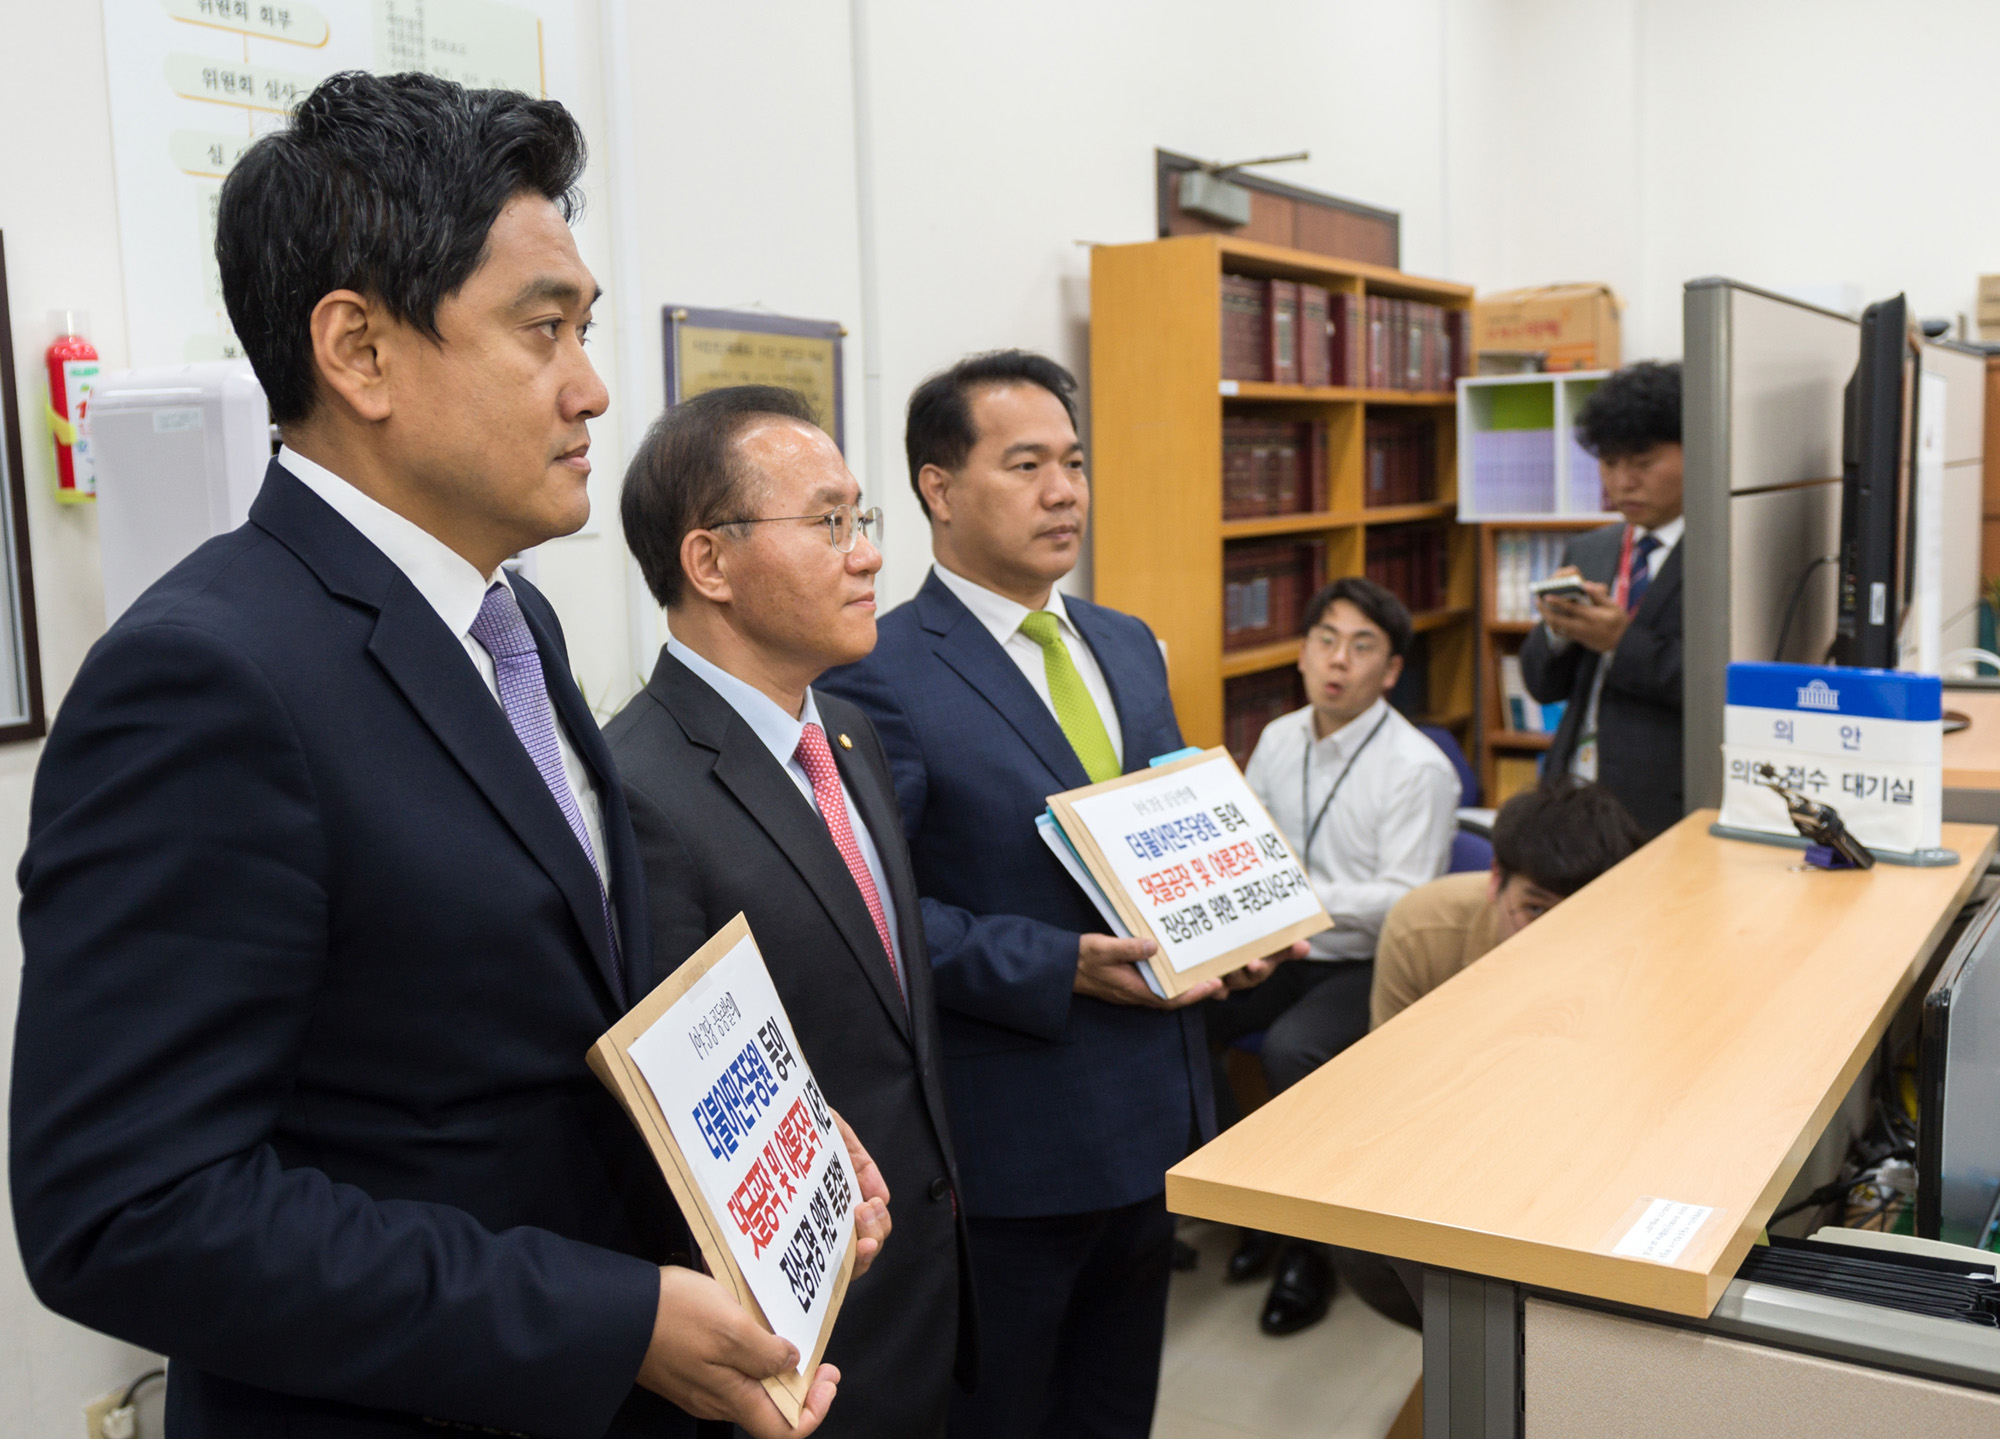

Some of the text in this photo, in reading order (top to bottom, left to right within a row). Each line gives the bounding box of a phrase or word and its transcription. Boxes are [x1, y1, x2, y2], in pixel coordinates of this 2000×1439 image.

[202, 67, 253, 96] 위원회
[1786, 765, 1829, 794] 접수
[1842, 773, 1915, 805] 대기실
[1125, 811, 1222, 861] 더불어민주당원
[1212, 801, 1250, 833] 등의
[1137, 831, 1289, 907] 댓글공작 및 여론조작 사건
[1159, 865, 1311, 944] 진상규명 위한 국정조사요구서
[691, 1016, 798, 1163] 더불어민주당원 등의
[726, 1074, 832, 1261] 댓글공작 및 여론조작 사건
[779, 1150, 852, 1314] 진상규명 위한 특검법
